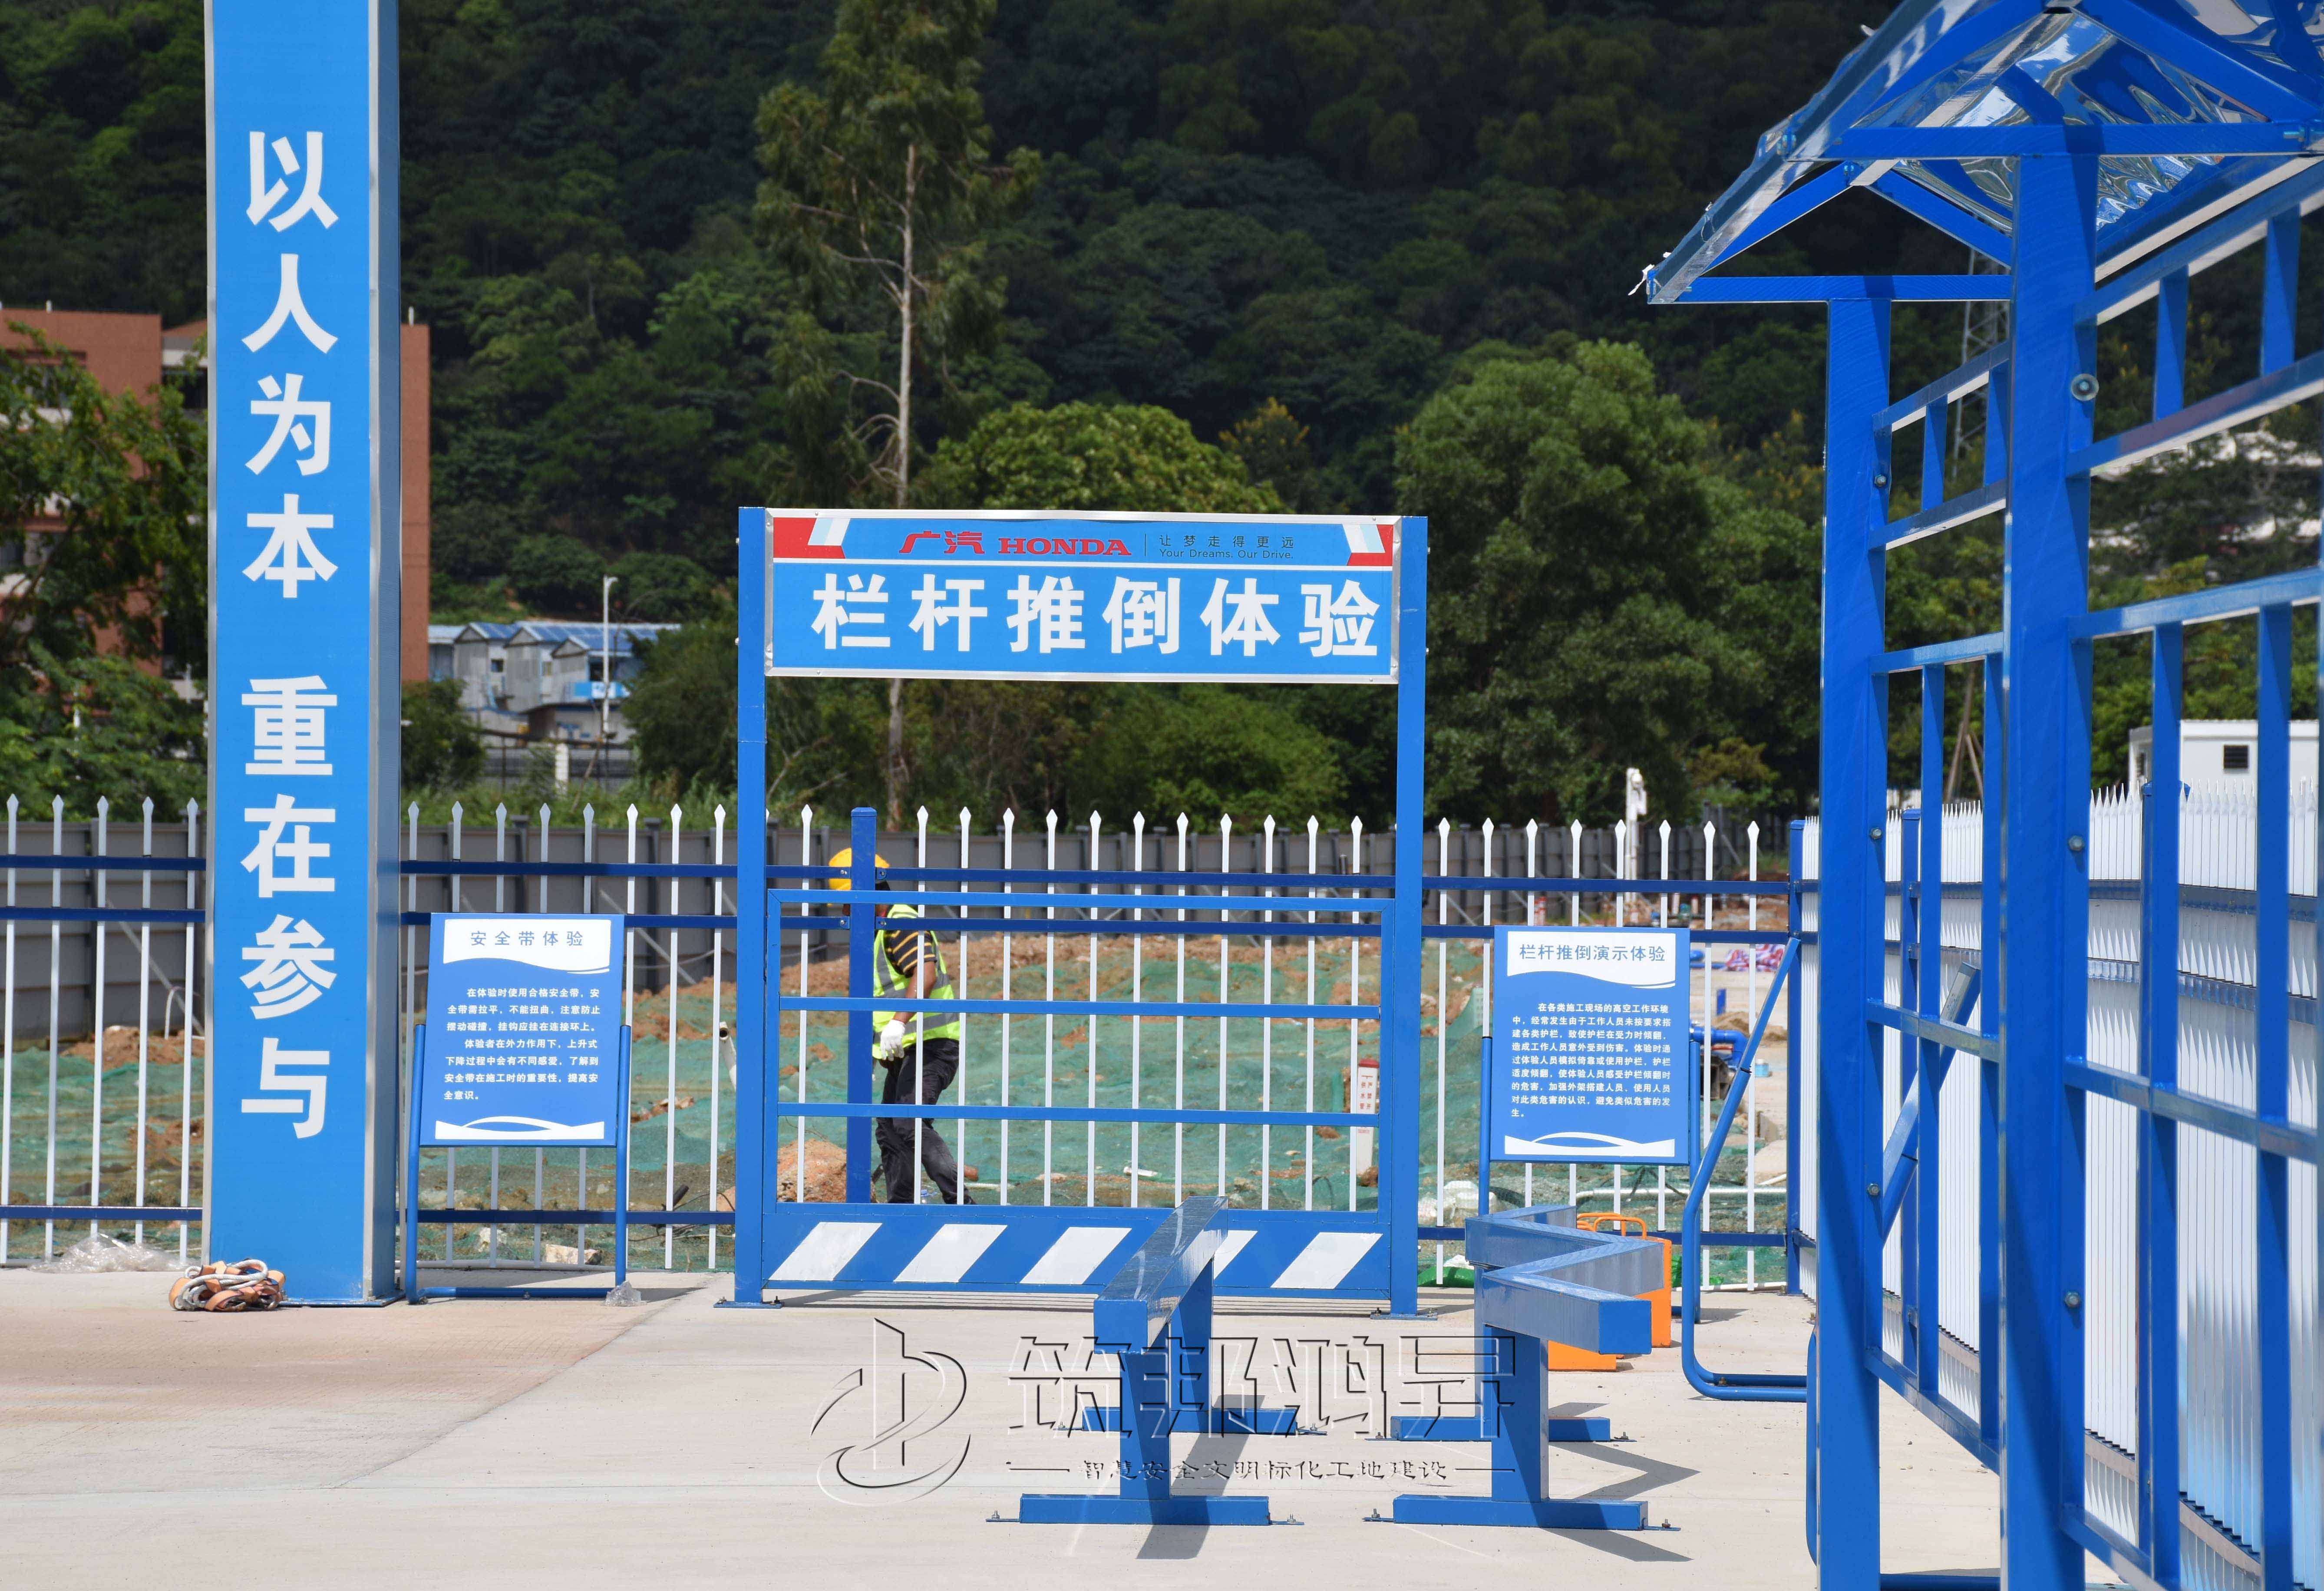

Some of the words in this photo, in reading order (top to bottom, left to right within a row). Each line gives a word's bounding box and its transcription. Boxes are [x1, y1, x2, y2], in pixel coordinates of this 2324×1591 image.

[242, 131, 338, 598] 以人为本
[899, 531, 985, 554] 广汽
[998, 538, 1132, 556] HONDA
[1159, 535, 1293, 548] 让梦走得更远
[1159, 549, 1184, 557] Your
[1190, 549, 1233, 558] Dreams.
[1238, 550, 1258, 558] Our
[1263, 550, 1293, 559] Drive.
[811, 573, 1380, 657] 栏杆推倒体验
[240, 675, 337, 1139] 重在参与
[470, 931, 583, 946] 安全带体验
[1519, 944, 1665, 961] 栏杆推倒演示体验
[444, 1090, 479, 1100] 全意识。
[1511, 1109, 1525, 1117] 生。
